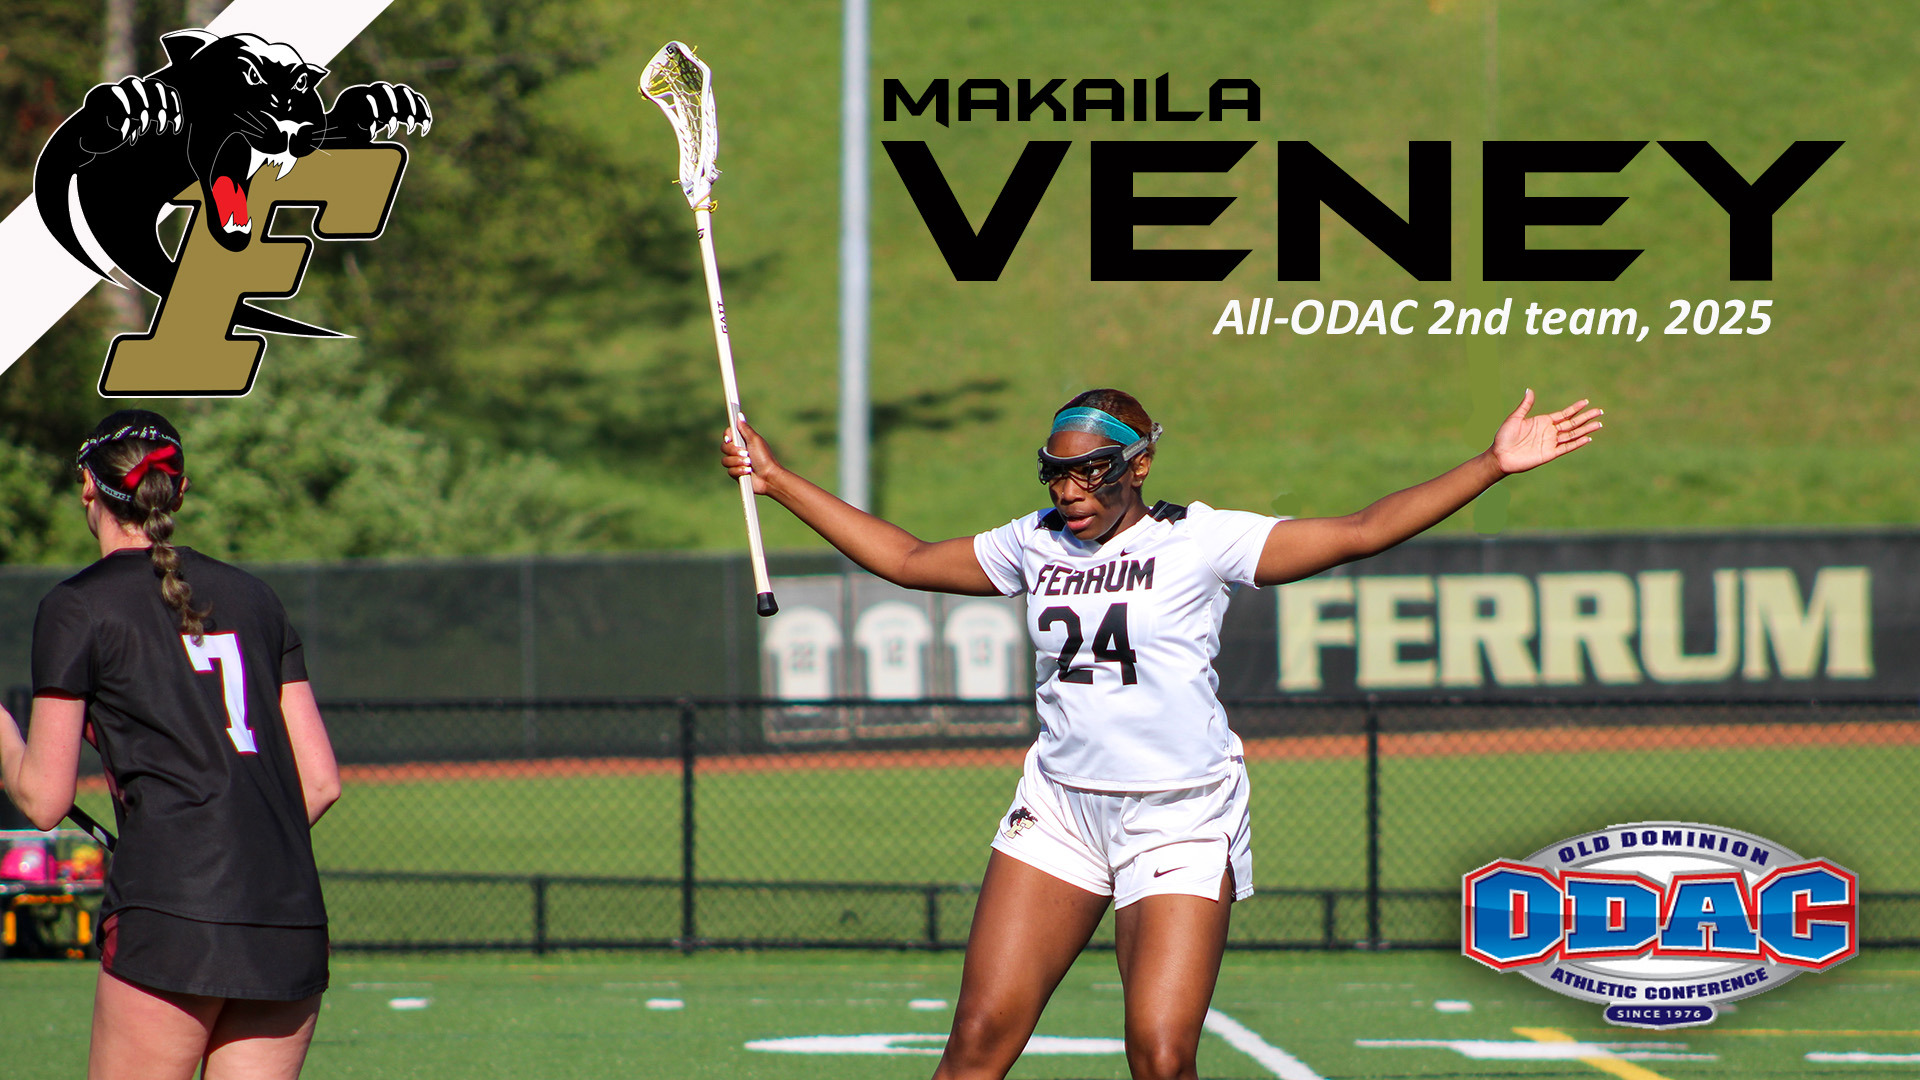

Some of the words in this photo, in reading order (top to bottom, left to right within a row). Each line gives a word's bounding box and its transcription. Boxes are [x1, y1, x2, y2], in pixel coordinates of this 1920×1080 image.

[1032, 557, 1156, 596] FERRUM
[1038, 602, 1138, 686] 24
[1277, 567, 1875, 690] FERRUM
[181, 632, 259, 754] 7
